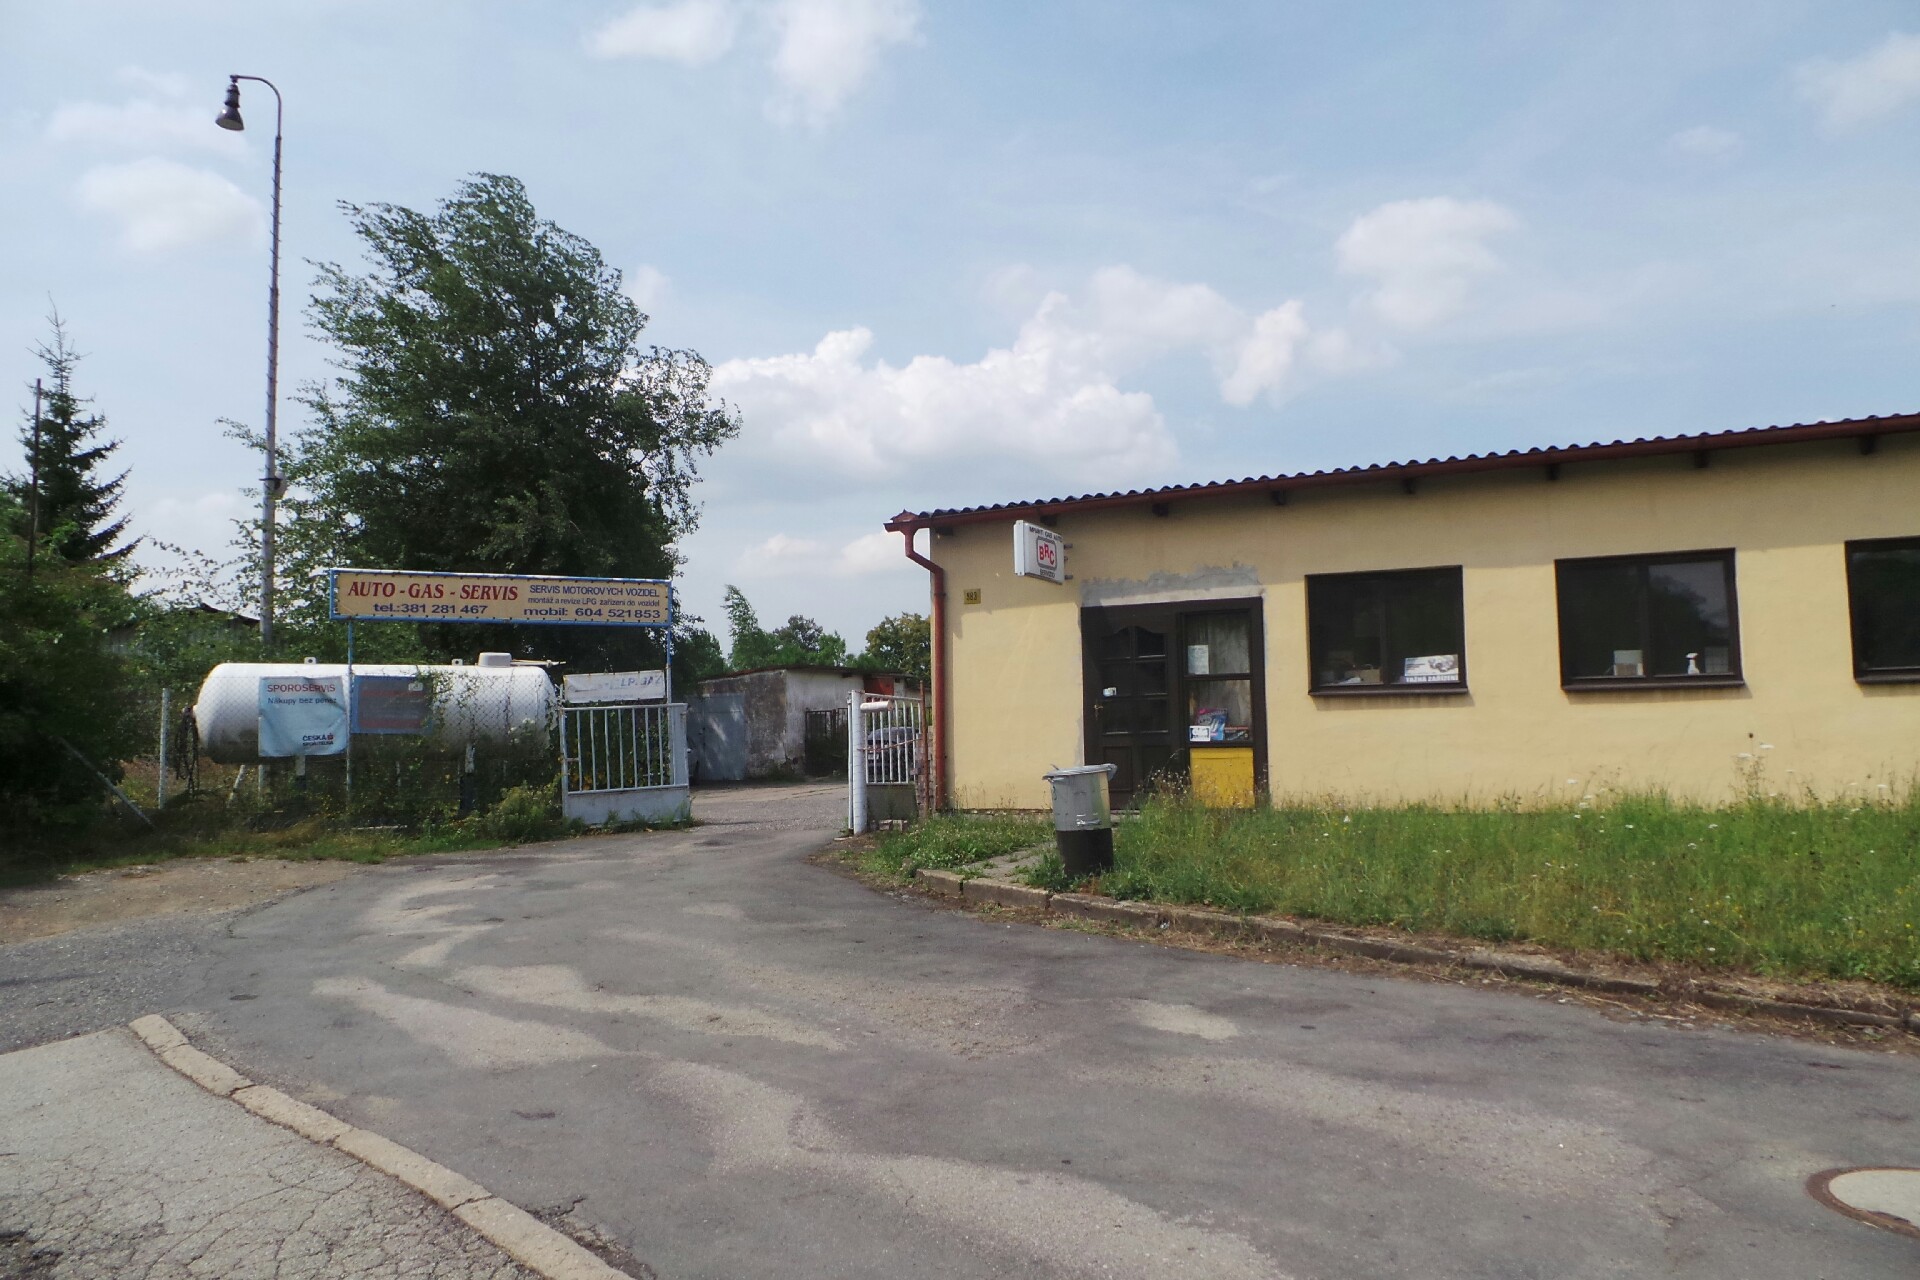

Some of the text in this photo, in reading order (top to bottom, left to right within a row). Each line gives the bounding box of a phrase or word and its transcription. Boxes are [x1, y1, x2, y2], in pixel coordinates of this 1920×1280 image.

[1040, 543, 1055, 565] BRC
[348, 581, 396, 597] AUTO
[408, 583, 444, 599] GAS
[460, 584, 518, 601] SERVIS
[530, 585, 561, 594] SERVIS
[626, 588, 660, 598] VOZIDEL
[431, 604, 456, 614] 281
[460, 605, 488, 614] 467
[524, 607, 568, 616] mobil:
[575, 608, 603, 617] 604
[267, 684, 336, 692] SPOROSERVIS
